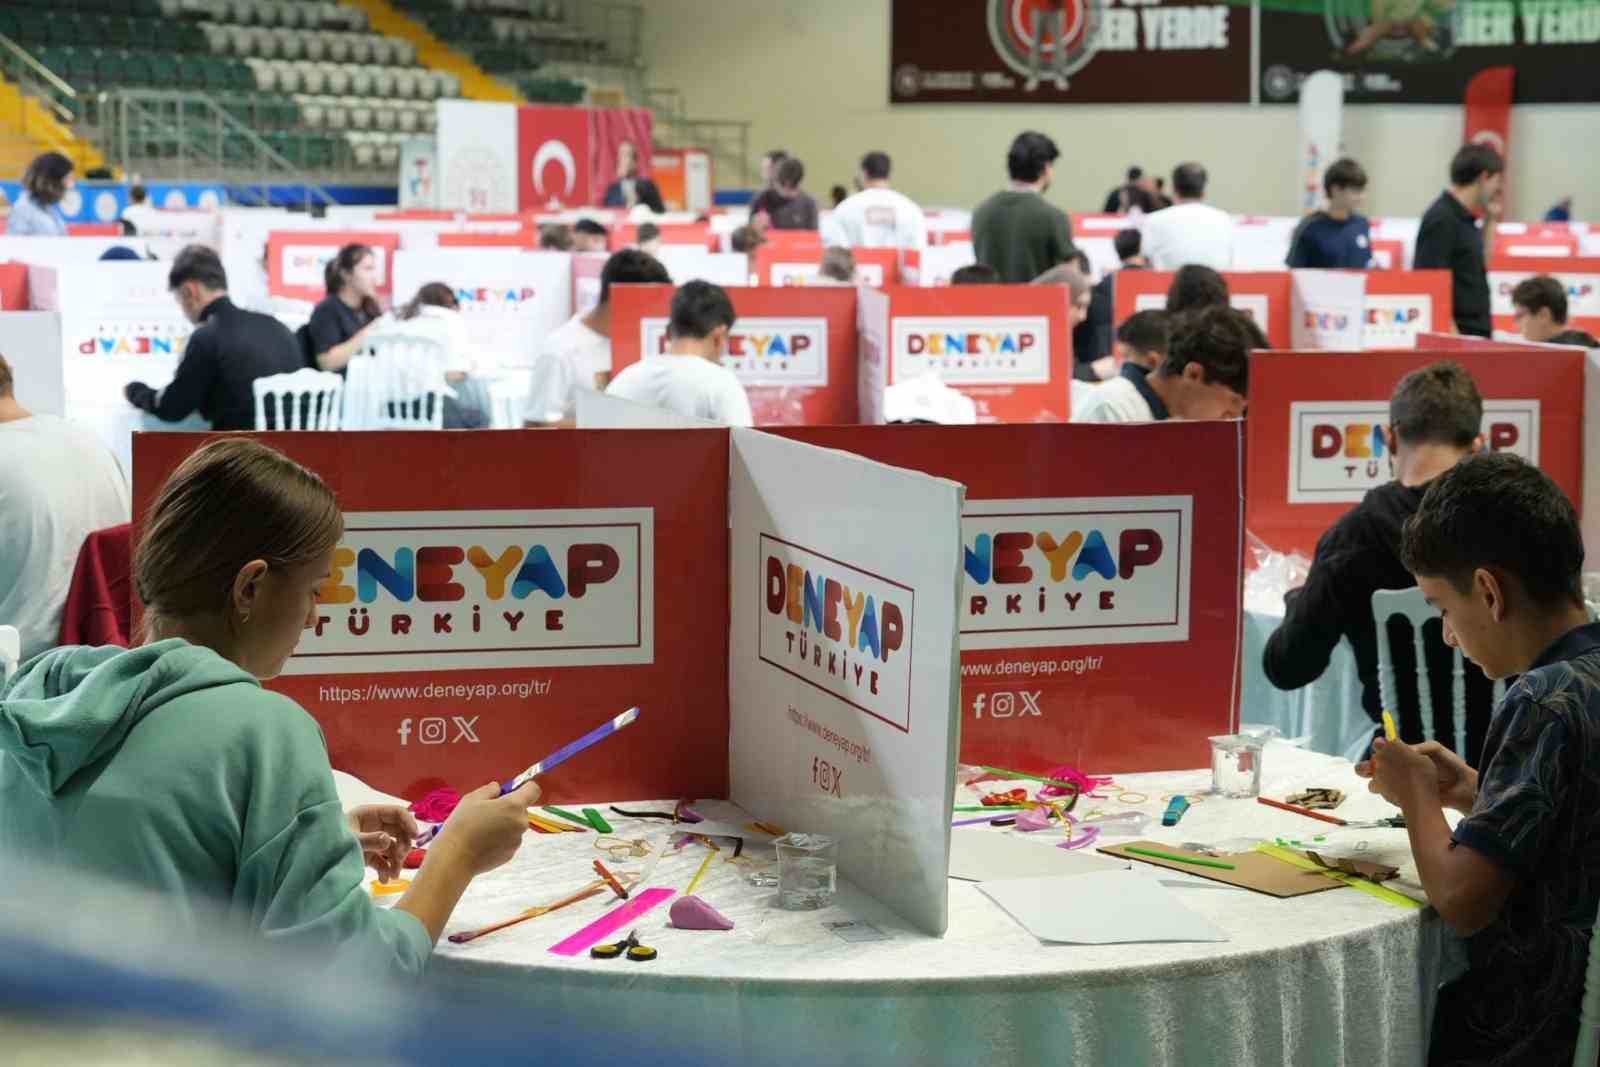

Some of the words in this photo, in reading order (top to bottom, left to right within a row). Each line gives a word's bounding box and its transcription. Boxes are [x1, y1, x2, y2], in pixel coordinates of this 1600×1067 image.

[1141, 6, 1230, 49] YERDE
[458, 287, 536, 302] NEYAP
[908, 333, 1035, 354] DENEYAP
[315, 542, 620, 604] ENEYAP
[964, 529, 1163, 585] NEYAP
[766, 555, 904, 663] DENEYAP
[970, 586, 1115, 616] RKİYE
[785, 629, 879, 696] TÜRKİYE
[961, 656, 1103, 676] www.deneyap.org/tr/
[319, 680, 551, 704] https://www.deneyap.org/tr/
